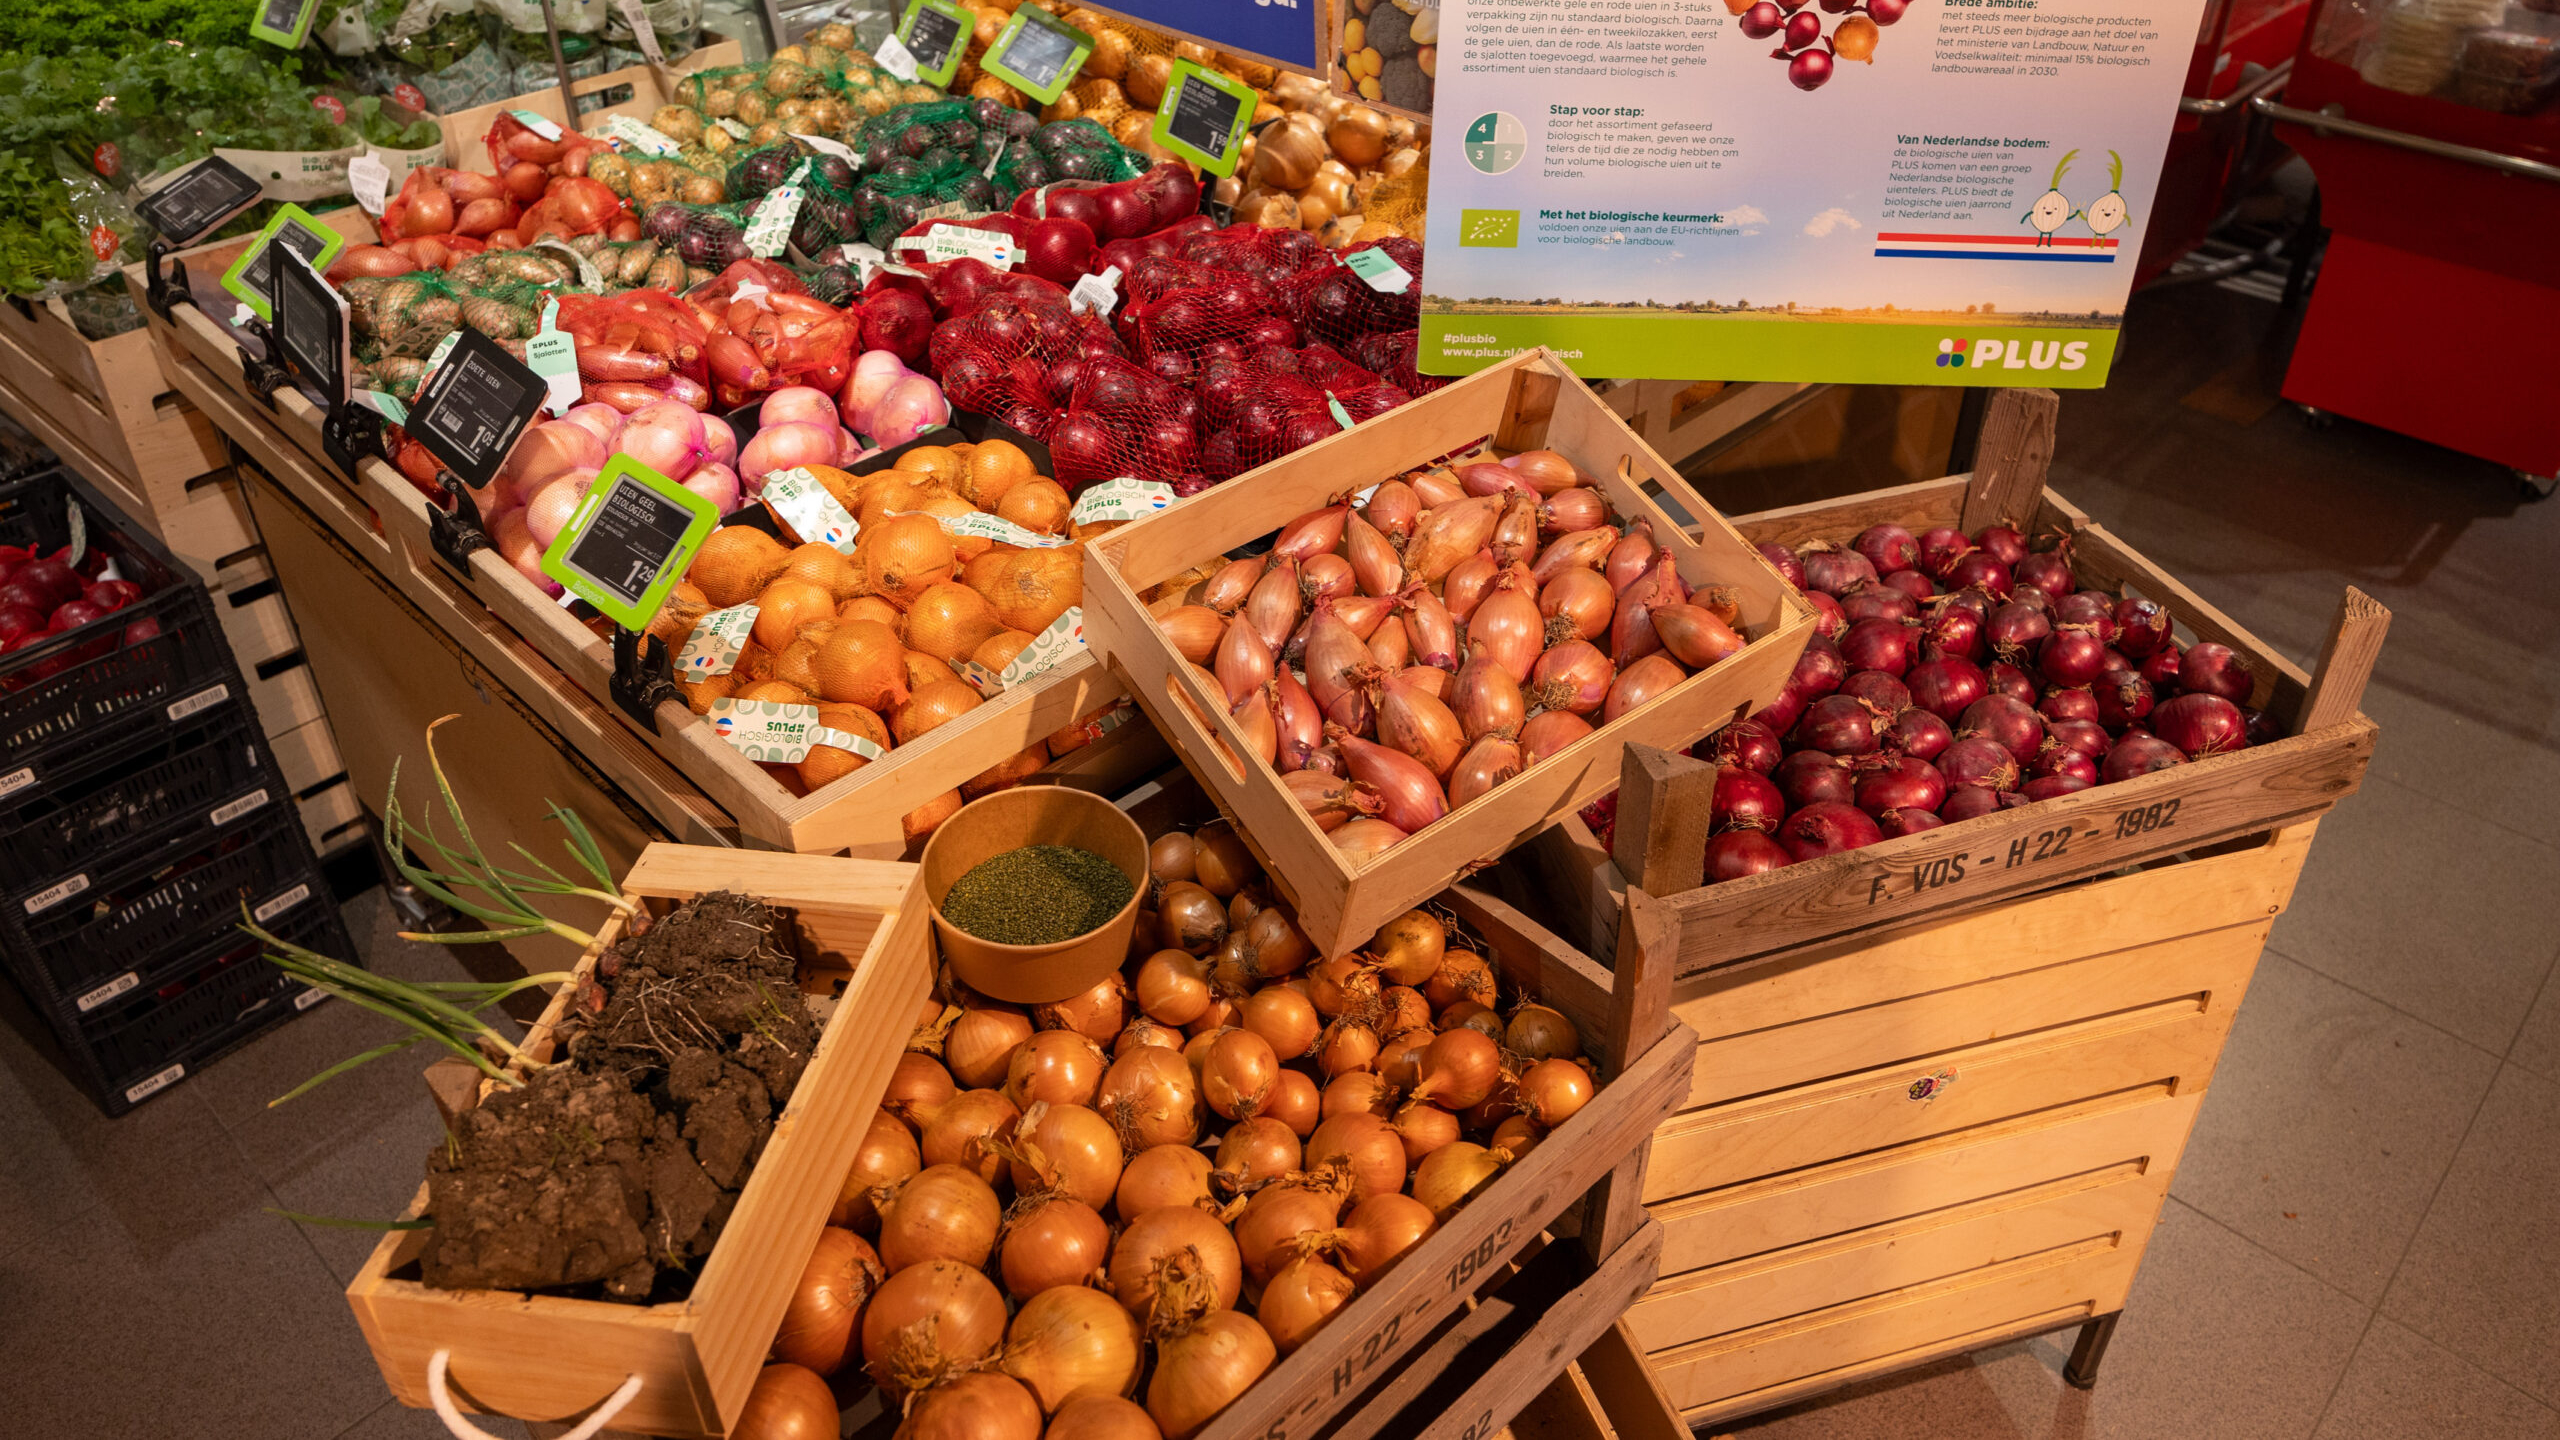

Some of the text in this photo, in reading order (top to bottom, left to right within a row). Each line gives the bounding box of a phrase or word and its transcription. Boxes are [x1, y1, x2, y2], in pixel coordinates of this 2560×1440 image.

[1985, 0, 2038, 9] ambitie:
[1466, 9, 1526, 23] verpakking
[1528, 10, 1548, 23] zijn
[1567, 11, 1621, 23] standaard
[1623, 13, 1681, 27] biologisch.
[1684, 14, 1723, 25] Daarna
[1941, 9, 2151, 28] met steeds meer biologische producten
[1465, 22, 1502, 35] volgen
[1504, 23, 1519, 33] de
[1521, 23, 1544, 34] uien
[1547, 24, 1557, 34] in
[1560, 24, 1583, 35] één-
[1603, 26, 1687, 40] tweekilozakken,
[1690, 28, 1717, 38] eerst
[1938, 23, 1969, 34] levert
[1971, 24, 2001, 35] PLUS
[2002, 28, 2022, 36] een
[2025, 25, 2069, 39] bijdrage
[2093, 27, 2111, 38] het
[2113, 28, 2137, 39] doel
[2139, 31, 2158, 39] van
[1463, 35, 1704, 51] de gele uien, dan de rode. Als laatste worden
[1936, 35, 1954, 46] het
[1956, 36, 2008, 48] ministerie
[2032, 38, 2090, 53] Landbouw,
[2092, 40, 2128, 51] Natuur
[2131, 44, 2144, 52] en
[1463, 49, 1707, 67] de sjalotten toegevoegd, waarmee het gehele
[1934, 49, 2150, 68] Voedselkwaliteit: minimaal 15% biologisch
[1462, 61, 1677, 79] assortiment uien standaard biologisch is.
[1930, 62, 2060, 75] landbouwareaal in 2030.
[1549, 103, 1644, 118] Stap voor stap:
[1547, 117, 1713, 133] door het assortiment gefaseerd
[1546, 129, 1600, 143] biologisch
[1603, 131, 1614, 141] te
[1616, 131, 1653, 145] maken,
[1656, 135, 1688, 146] geven
[1691, 136, 1706, 144] we
[1896, 133, 2050, 148] Van Nederlandse bodem:
[1892, 147, 2014, 162] de biologische uien van
[1890, 159, 2032, 175] PLUS komen van een groep
[1888, 171, 2014, 187] Nederlandse biologische
[1886, 184, 2014, 197] uientelers. PLUS biedt de
[1883, 195, 2011, 212] biologische uien jaarrond
[1539, 208, 1724, 224] Met het biologische keurmerk:
[1881, 207, 1974, 220] uit Nederland aan.
[944, 246, 968, 256] PLUS
[538, 339, 558, 348] PLUS
[1443, 333, 1497, 344] #plusbio
[533, 347, 567, 359] Sjalotten
[1970, 339, 2089, 370] PLUS
[467, 360, 501, 390] ZOETE UIEN
[619, 484, 657, 512] UIEN GEEL
[1086, 491, 1146, 506] BIOLOGISCH
[1094, 499, 1122, 509] PLUS
[611, 494, 657, 525] BIOLOGISCH
[977, 523, 1007, 535] PLUS
[709, 617, 727, 637] PLUS
[711, 611, 741, 653] BIOLOGISCH
[766, 721, 796, 733] PLUS
[738, 729, 803, 744] BIOLOGISCH
[1868, 872, 1894, 905] F.
[1913, 852, 1969, 893] VOS
[2005, 836, 2029, 869] H
[2031, 826, 2073, 863] 22
[2114, 798, 2181, 840] 1982
[31, 887, 61, 906] 15404
[84, 986, 112, 1004] 15404
[1332, 1362, 1352, 1397] H
[1361, 1315, 1401, 1373] 22
[1444, 1217, 1513, 1294] 1982
